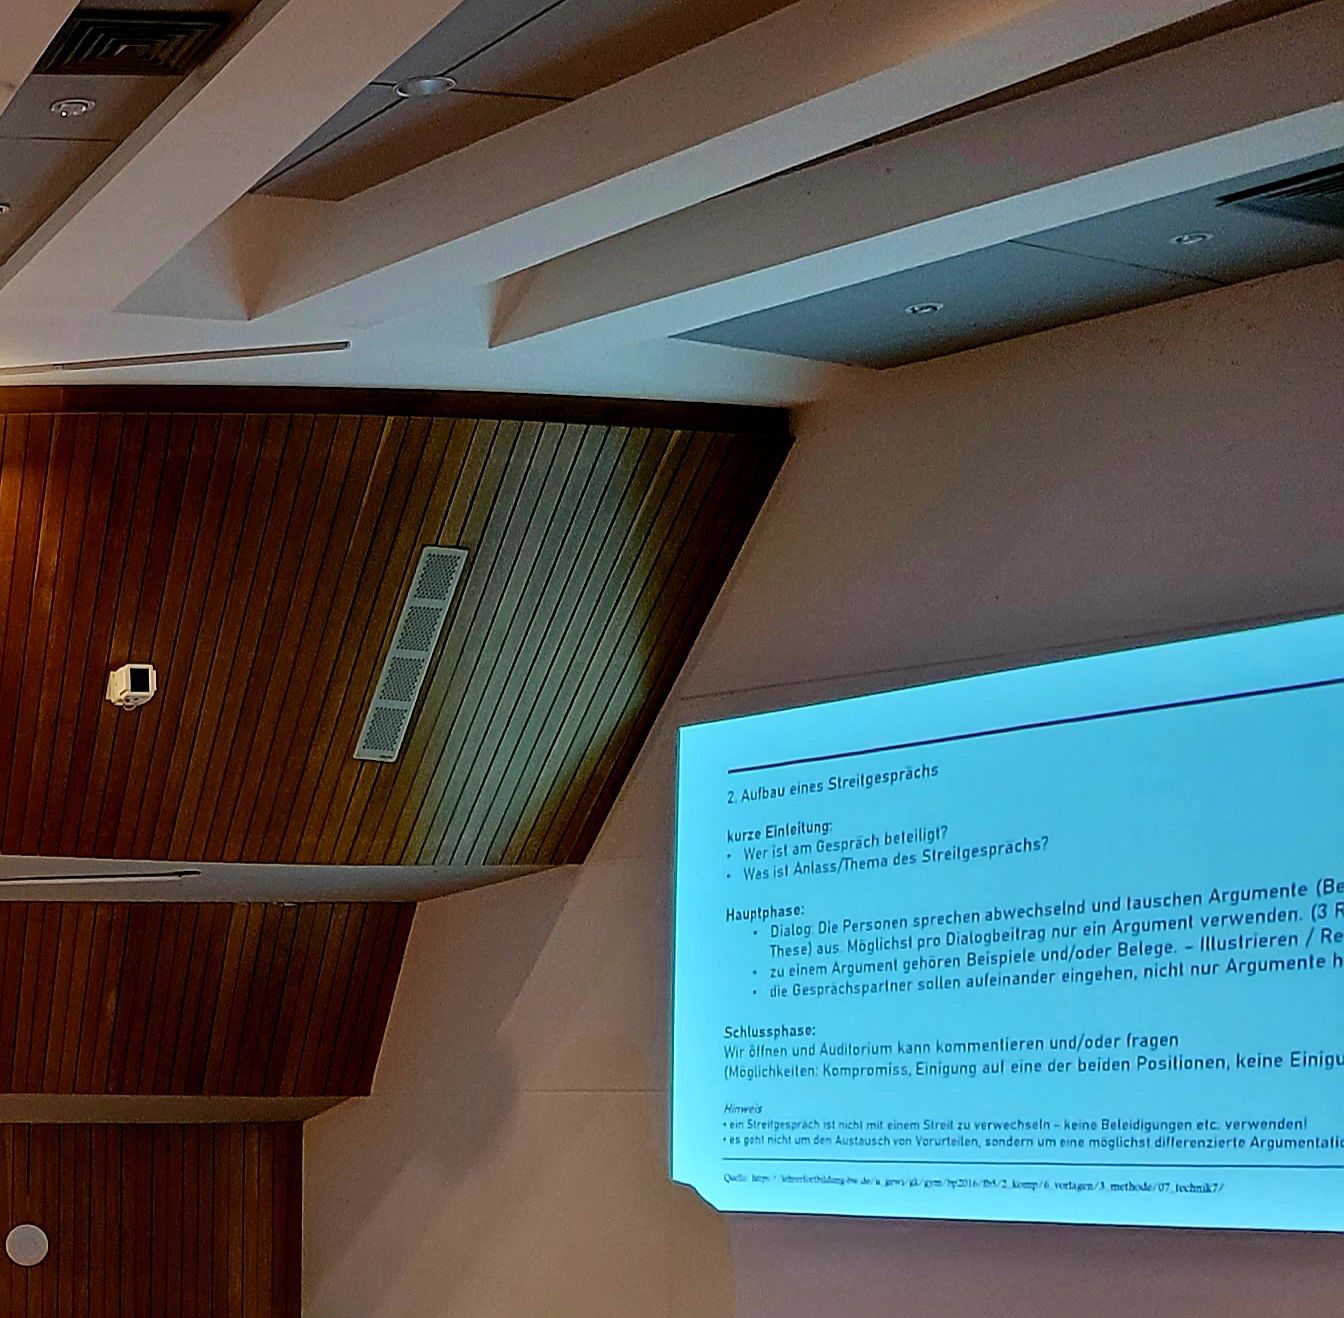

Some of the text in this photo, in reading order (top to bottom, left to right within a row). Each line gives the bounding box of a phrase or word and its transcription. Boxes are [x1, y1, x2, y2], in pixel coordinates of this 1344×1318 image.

[741, 785, 785, 802] Aufbau
[790, 780, 823, 795] eines
[727, 828, 761, 841] kurze
[744, 846, 768, 860] Wer
[772, 843, 788, 857] ist
[792, 844, 812, 855] am
[884, 824, 948, 845] beteiligt?
[744, 866, 769, 879] Was
[773, 863, 789, 877] ist
[793, 856, 888, 876] Anlass/Thema
[893, 852, 917, 866] des
[726, 904, 805, 922] Hauptphase:
[818, 920, 838, 934] Die
[843, 917, 908, 932] Personen
[912, 909, 980, 929] sprechen
[985, 899, 1085, 921] abwechselnd
[1092, 896, 1121, 912] und
[1127, 891, 1202, 910] tauschen
[1208, 882, 1308, 905] Argumente
[770, 941, 812, 959] These)
[847, 934, 912, 955] Möglichst
[917, 936, 941, 951] pro
[946, 926, 1046, 946] Dialogbeitrag
[1051, 926, 1077, 938] nur
[1083, 920, 1106, 936] ein
[1112, 913, 1193, 936] Argument
[1200, 908, 1302, 927] verwenden.
[1311, 903, 1328, 923] (3
[770, 967, 784, 978] zu
[788, 962, 828, 976] einem
[832, 957, 898, 976] Argument
[967, 948, 1036, 968] Beispiele
[1041, 944, 1112, 963] und/oder
[1118, 941, 1177, 958] Belege.
[1200, 932, 1299, 951] Illustrieren
[770, 984, 788, 998] die
[917, 975, 961, 990] sollen
[966, 970, 1055, 987] aufeinander
[1144, 961, 1184, 978] nicht
[1190, 963, 1219, 975] nur
[1226, 953, 1326, 975] Argumente
[724, 1023, 816, 1040] Schlussphase:
[724, 1044, 744, 1058] Wir
[792, 1042, 815, 1056] und
[819, 1041, 892, 1056] Auditorium
[897, 1040, 930, 1054] kann
[936, 1037, 1044, 1053] kommentieren
[1049, 1033, 1120, 1052] und/oder
[1126, 1032, 1179, 1050] fragen
[822, 1062, 912, 1079] Kompromiss,
[915, 1061, 977, 1078] Einigung
[982, 1059, 1004, 1073] auf
[1011, 1059, 1042, 1073] eine
[1047, 1058, 1072, 1072] der
[1077, 1057, 1130, 1072] beiden
[1136, 1055, 1230, 1070] Positionen,
[1236, 1053, 1283, 1068] keine
